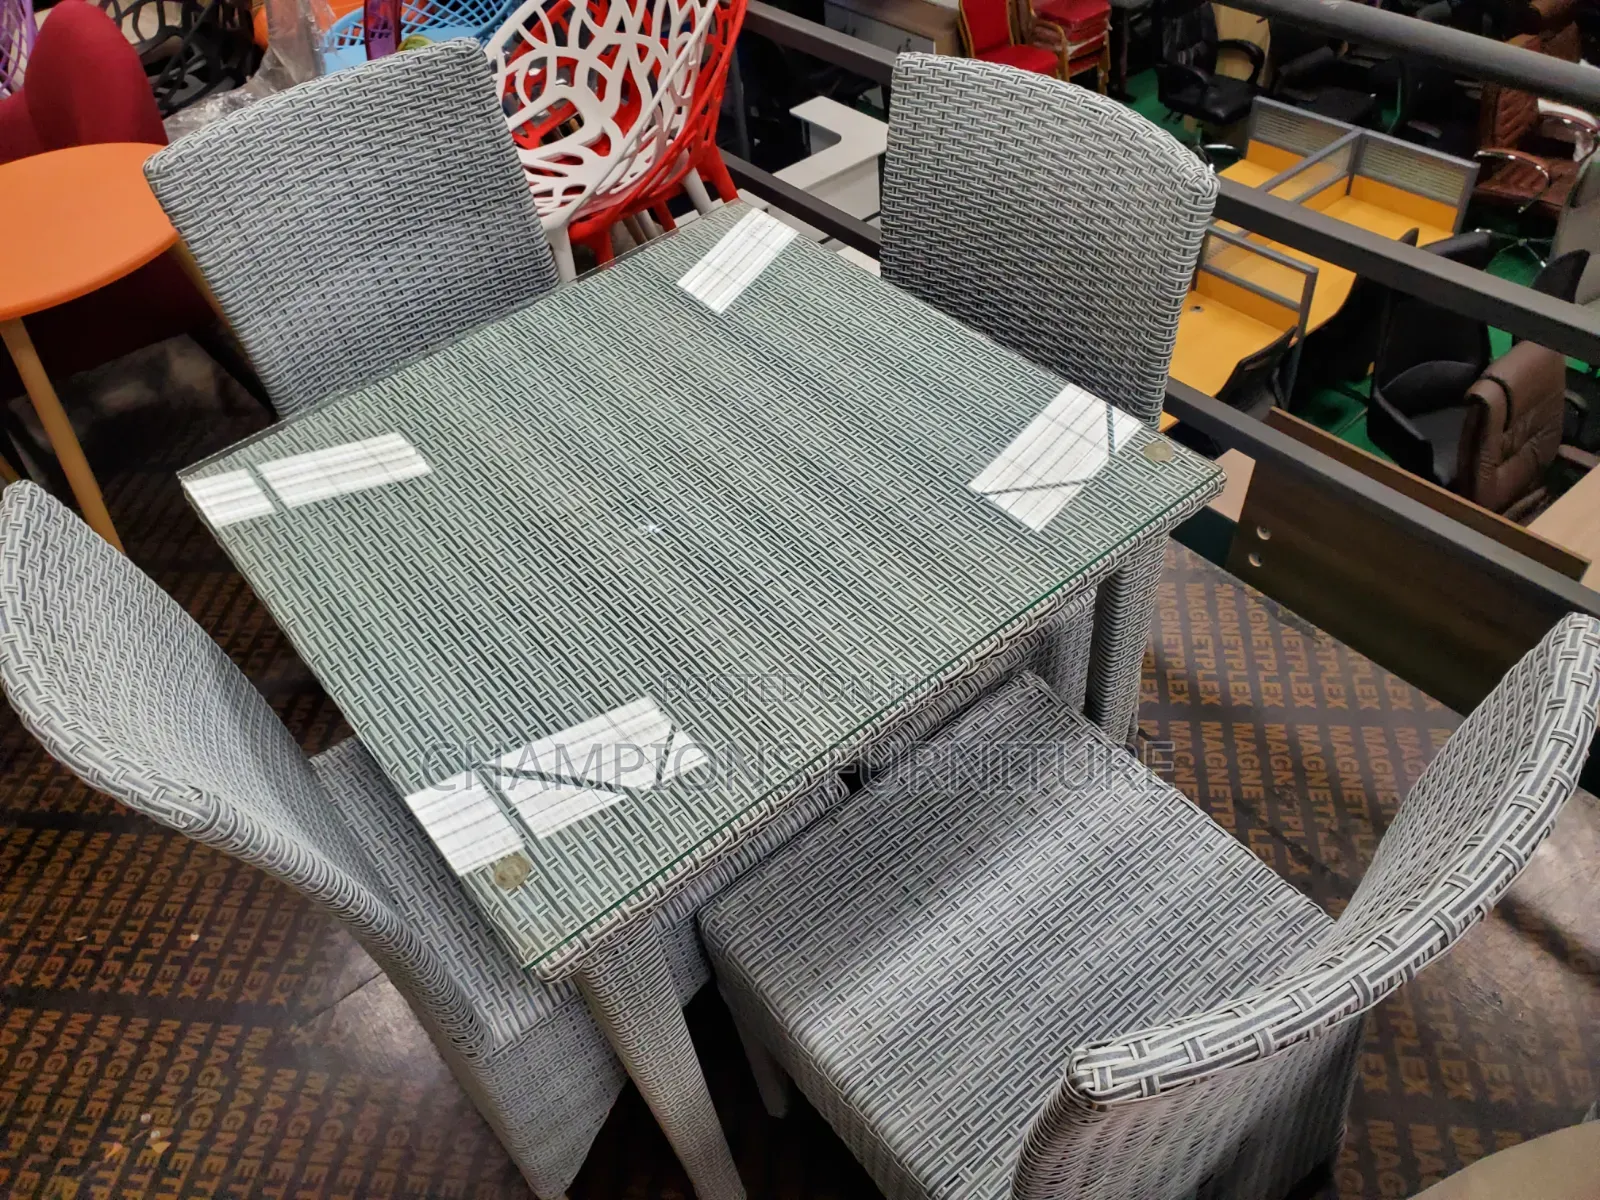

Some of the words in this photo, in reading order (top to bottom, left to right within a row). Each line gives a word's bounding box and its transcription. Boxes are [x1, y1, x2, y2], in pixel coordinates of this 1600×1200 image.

[1185, 583, 1222, 705] MAGNETPLEX
[1213, 583, 1253, 706] MAGNETPLEX
[31, 832, 139, 988] MAGNETPLEX
[60, 834, 165, 992] MAGNETPLEX
[89, 836, 191, 993] MAGNETPLEX
[148, 853, 232, 999] AGNETPLEX
